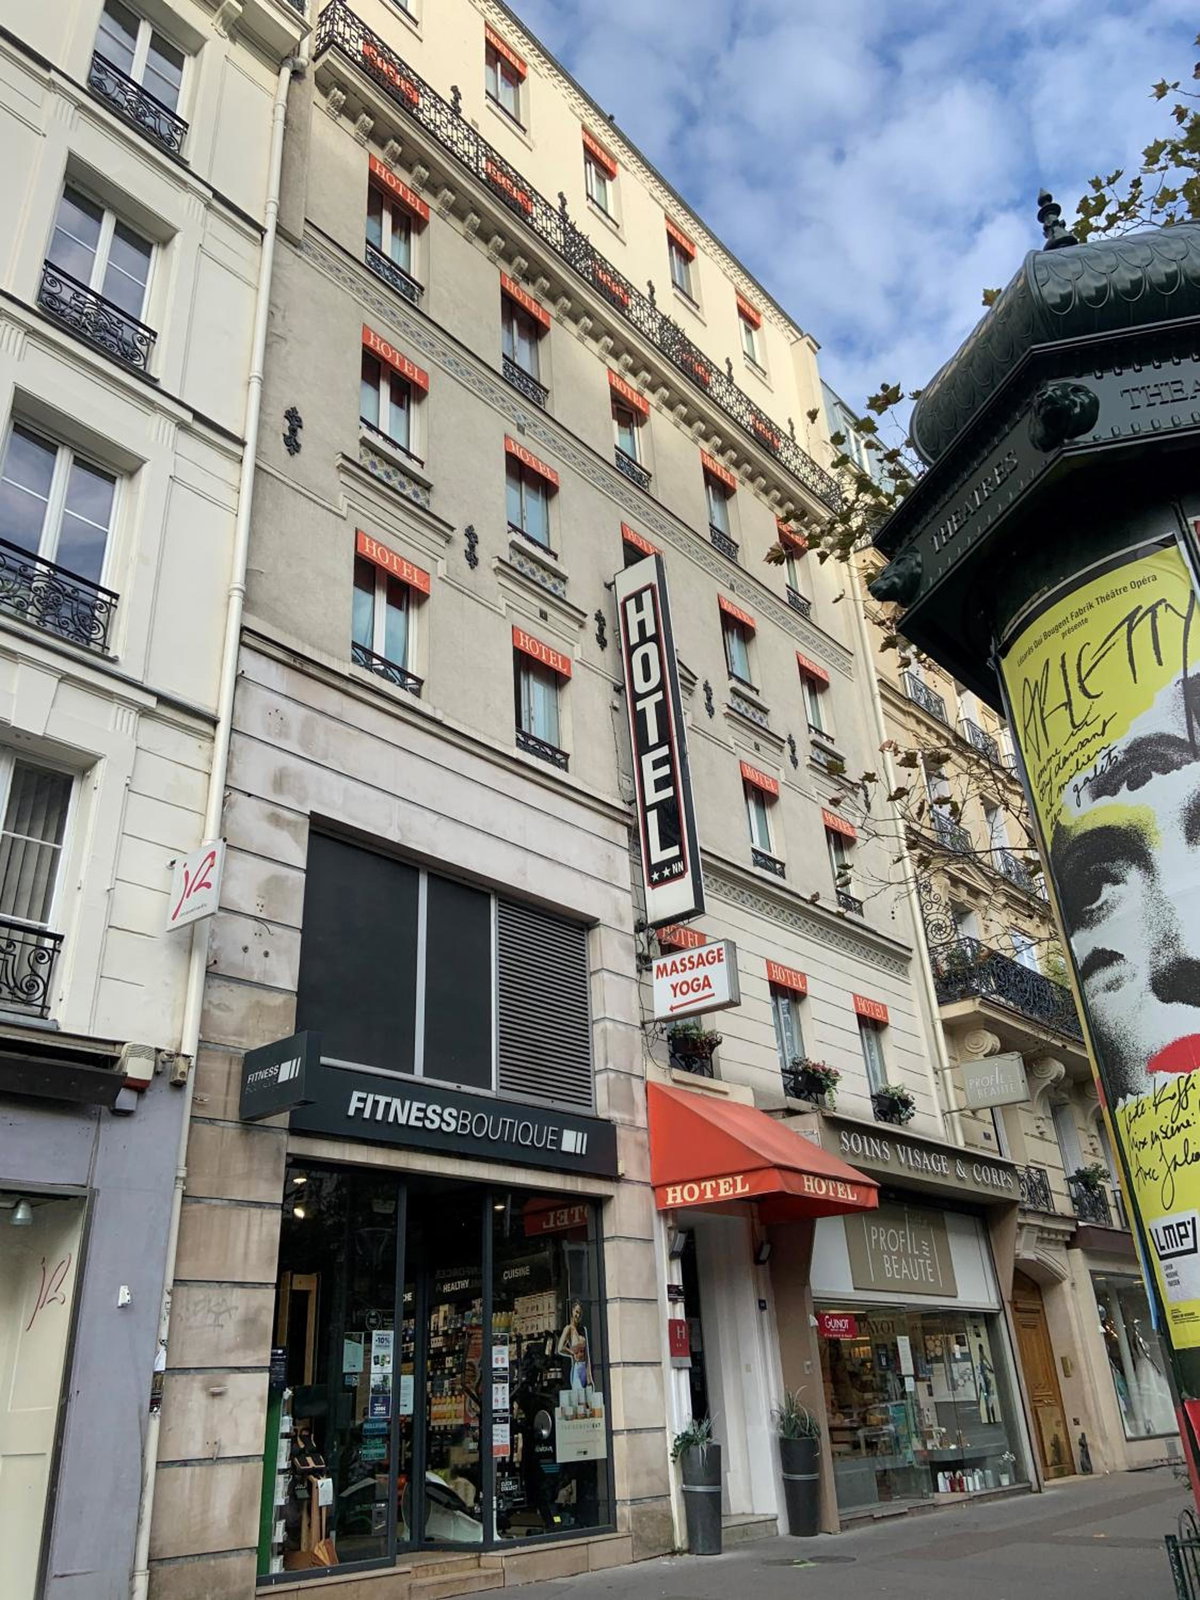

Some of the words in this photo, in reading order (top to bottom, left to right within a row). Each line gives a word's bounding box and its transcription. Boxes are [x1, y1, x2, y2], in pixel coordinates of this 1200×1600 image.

[374, 160, 424, 214] HOTEL
[505, 277, 546, 322] HOTEL
[369, 332, 423, 383] HOTEL
[613, 374, 647, 412] HOTEL
[509, 440, 556, 482] HOTEL
[365, 536, 424, 588] HOTEL
[1042, 618, 1070, 641] Bougent
[1070, 601, 1095, 622] Fabrik
[1095, 584, 1129, 606] Théâtre
[1130, 574, 1158, 591] Opéra
[1061, 617, 1089, 640] présente
[519, 631, 567, 673] HOTEL
[628, 590, 681, 867] HOTEL
[743, 761, 776, 791] HOTEL
[1057, 743, 1111, 798] milieu
[1073, 745, 1118, 808] galets
[655, 947, 725, 980] MASSAGE
[770, 961, 806, 990] HOTEL
[670, 975, 713, 998] YOGA
[856, 996, 888, 1020] HOTEL
[247, 1064, 280, 1084] FITNESS
[1153, 1072, 1197, 1123] Koffi
[347, 1090, 559, 1151] FITNESSBOUTIQUE
[840, 1131, 891, 1162] SOINS
[896, 1144, 950, 1176] VISAGE
[956, 1159, 968, 1179] &
[973, 1164, 1015, 1190] CORPS
[666, 1176, 750, 1205] HOTEL
[803, 1174, 858, 1201] HOTEL
[443, 1279, 470, 1293] HEALTHY
[503, 1265, 530, 1280] CUISINE
[883, 1255, 935, 1283] BEAUTE
[677, 1325, 686, 1339] H
